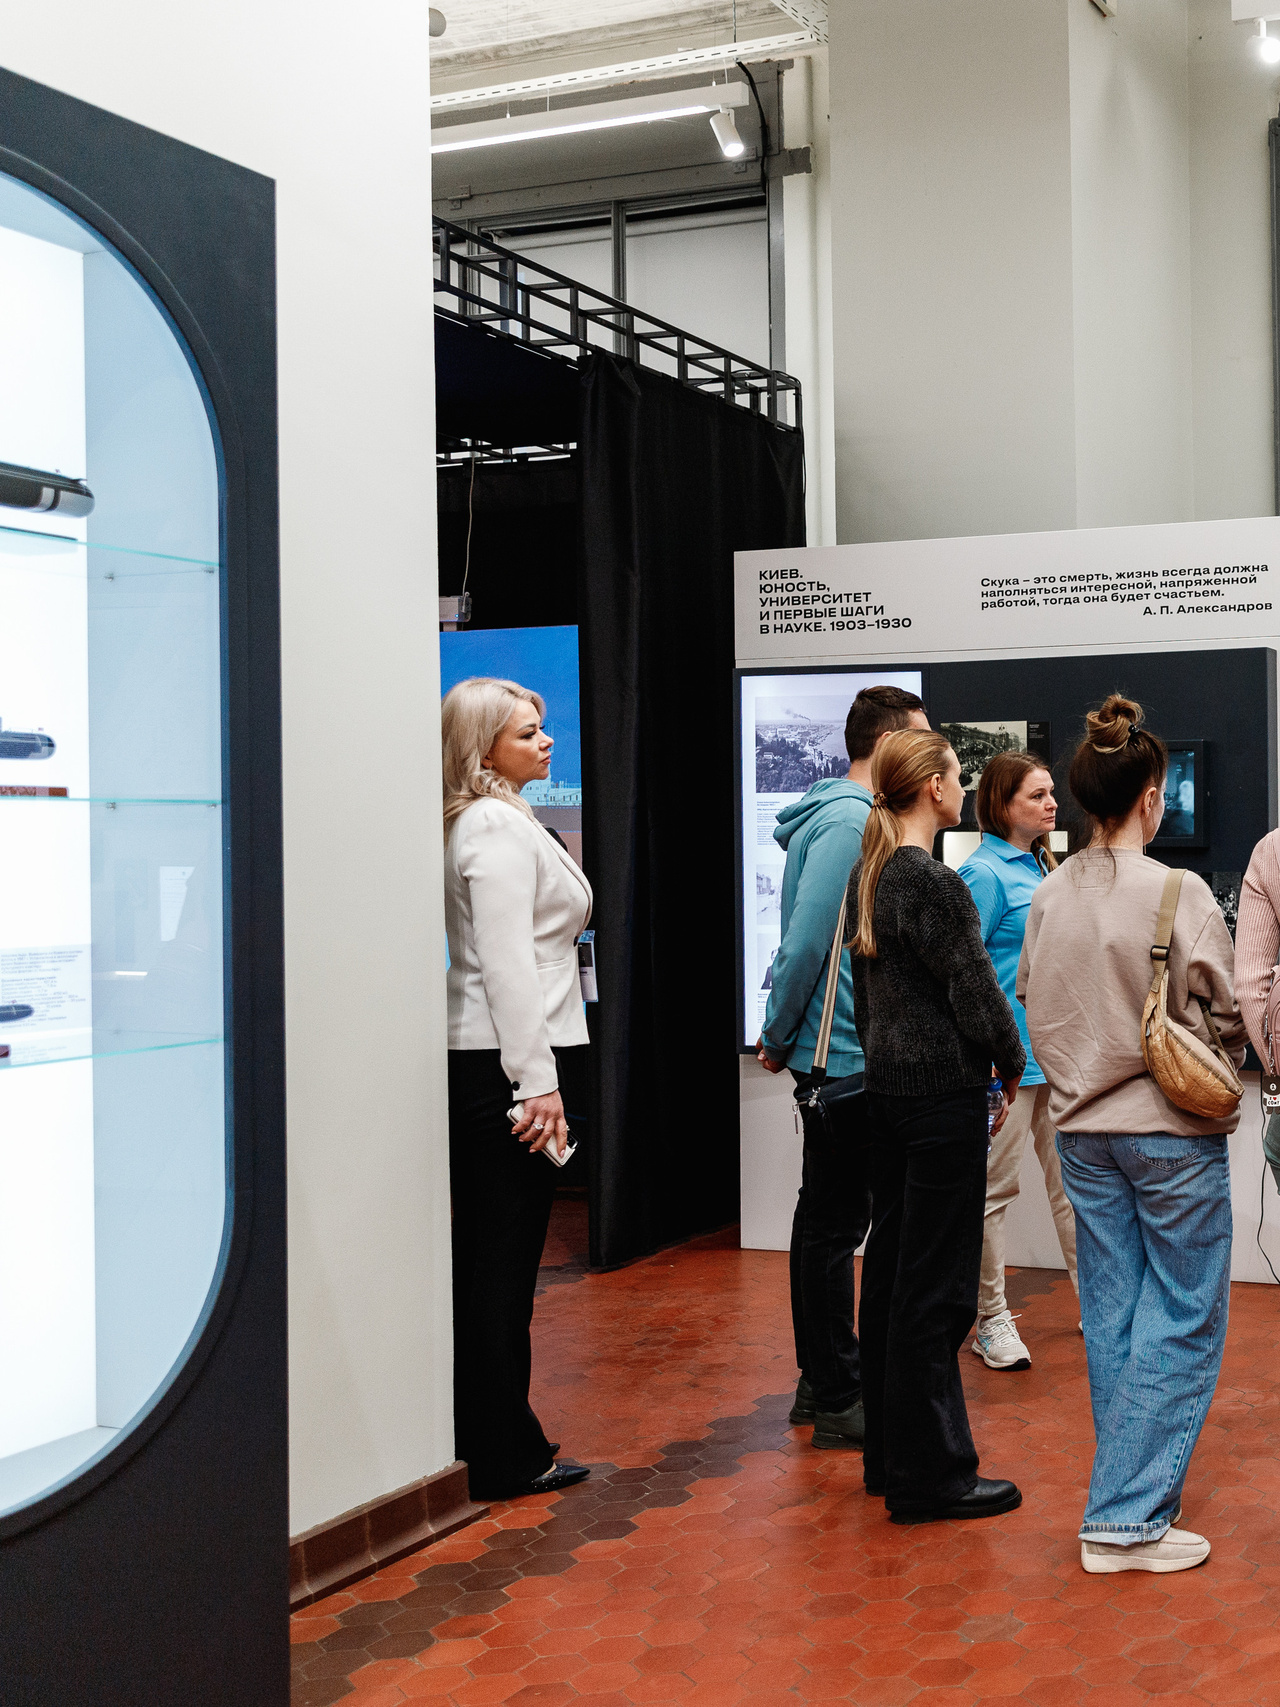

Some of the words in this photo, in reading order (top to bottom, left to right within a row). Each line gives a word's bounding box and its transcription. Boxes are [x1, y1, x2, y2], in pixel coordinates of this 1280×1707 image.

[759, 569, 803, 580] КИЕВ.
[981, 578, 1019, 588] Скука
[1034, 576, 1056, 584] это
[1060, 574, 1112, 583] смерть,
[1116, 571, 1158, 579] жизнь
[1162, 568, 1210, 576] всегда
[1214, 565, 1268, 575] должна
[760, 581, 830, 594] ЮНОСТЬ,
[981, 587, 1066, 598] наполняться
[1071, 580, 1156, 593] интересной,
[1160, 574, 1256, 589] напряженной
[759, 592, 871, 607] УНИВЕРСИТЕТ
[982, 597, 1039, 610] работой,
[1043, 597, 1080, 605] тогда
[1083, 595, 1107, 603] она
[1111, 593, 1150, 603] будет
[1154, 590, 1224, 599] счастьем.
[760, 611, 769, 621] И
[774, 608, 836, 620] ПЕРВЫЕ
[841, 605, 884, 617] ШАГИ
[1143, 607, 1156, 615] А.
[1161, 606, 1173, 614] П.
[1177, 603, 1272, 614] Александров
[760, 624, 769, 634] В
[774, 622, 826, 633] НАУКЕ.
